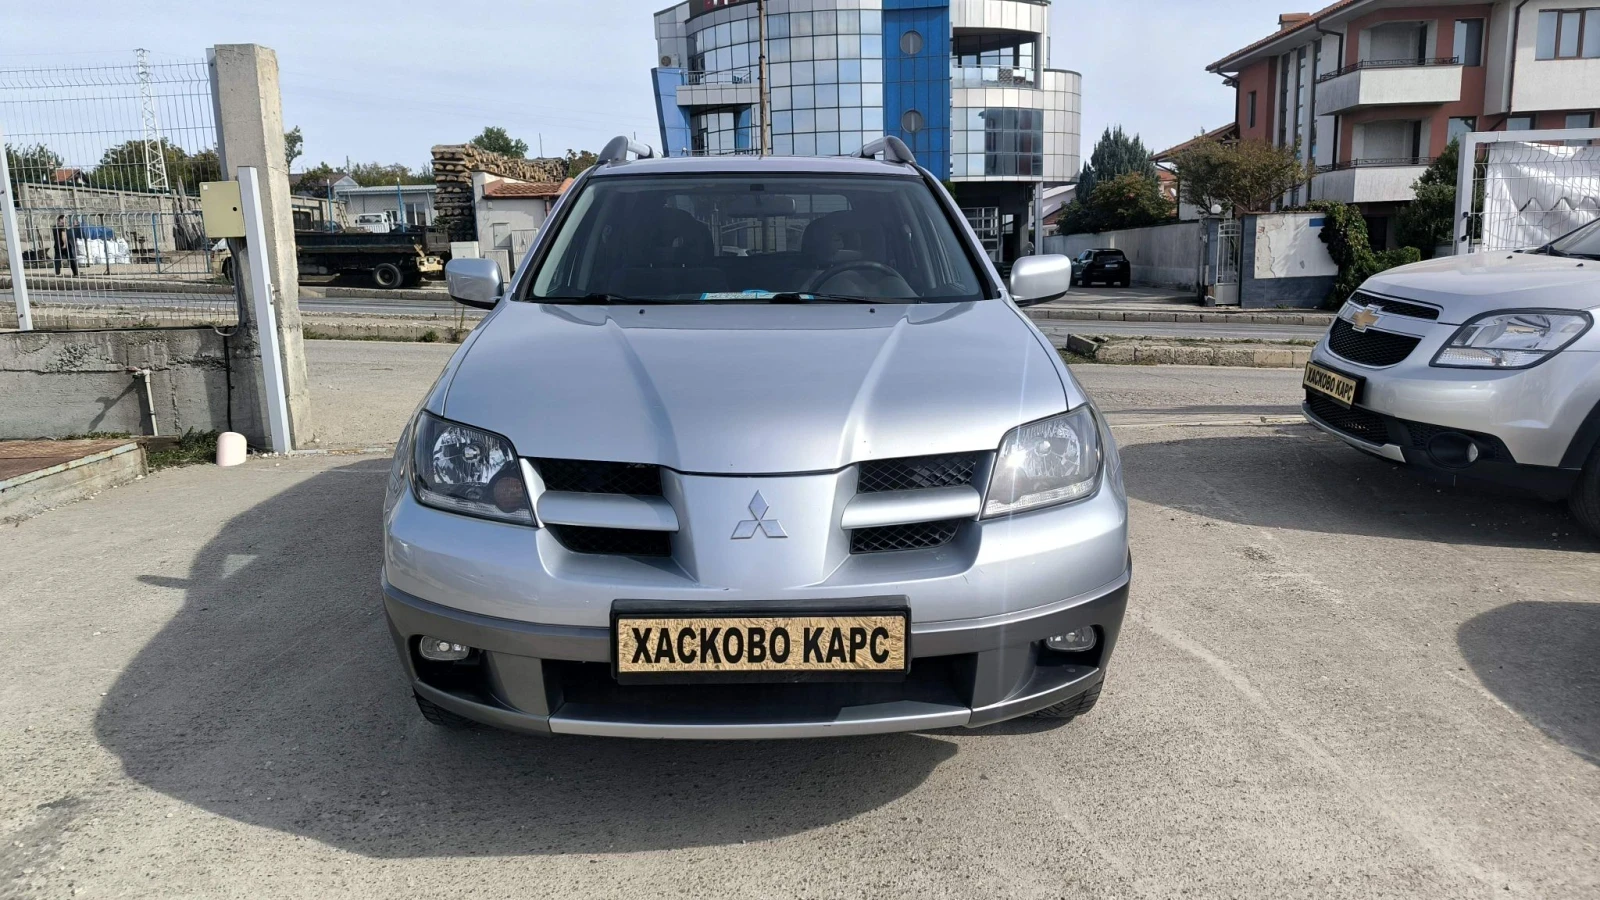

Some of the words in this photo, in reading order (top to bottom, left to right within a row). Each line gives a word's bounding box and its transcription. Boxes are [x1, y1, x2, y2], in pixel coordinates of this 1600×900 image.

[1306, 367, 1335, 392] ХАСКОВО
[1335, 379, 1353, 401] КАРС
[631, 626, 791, 665] ХАСКОВО
[803, 626, 890, 664] КАРС
